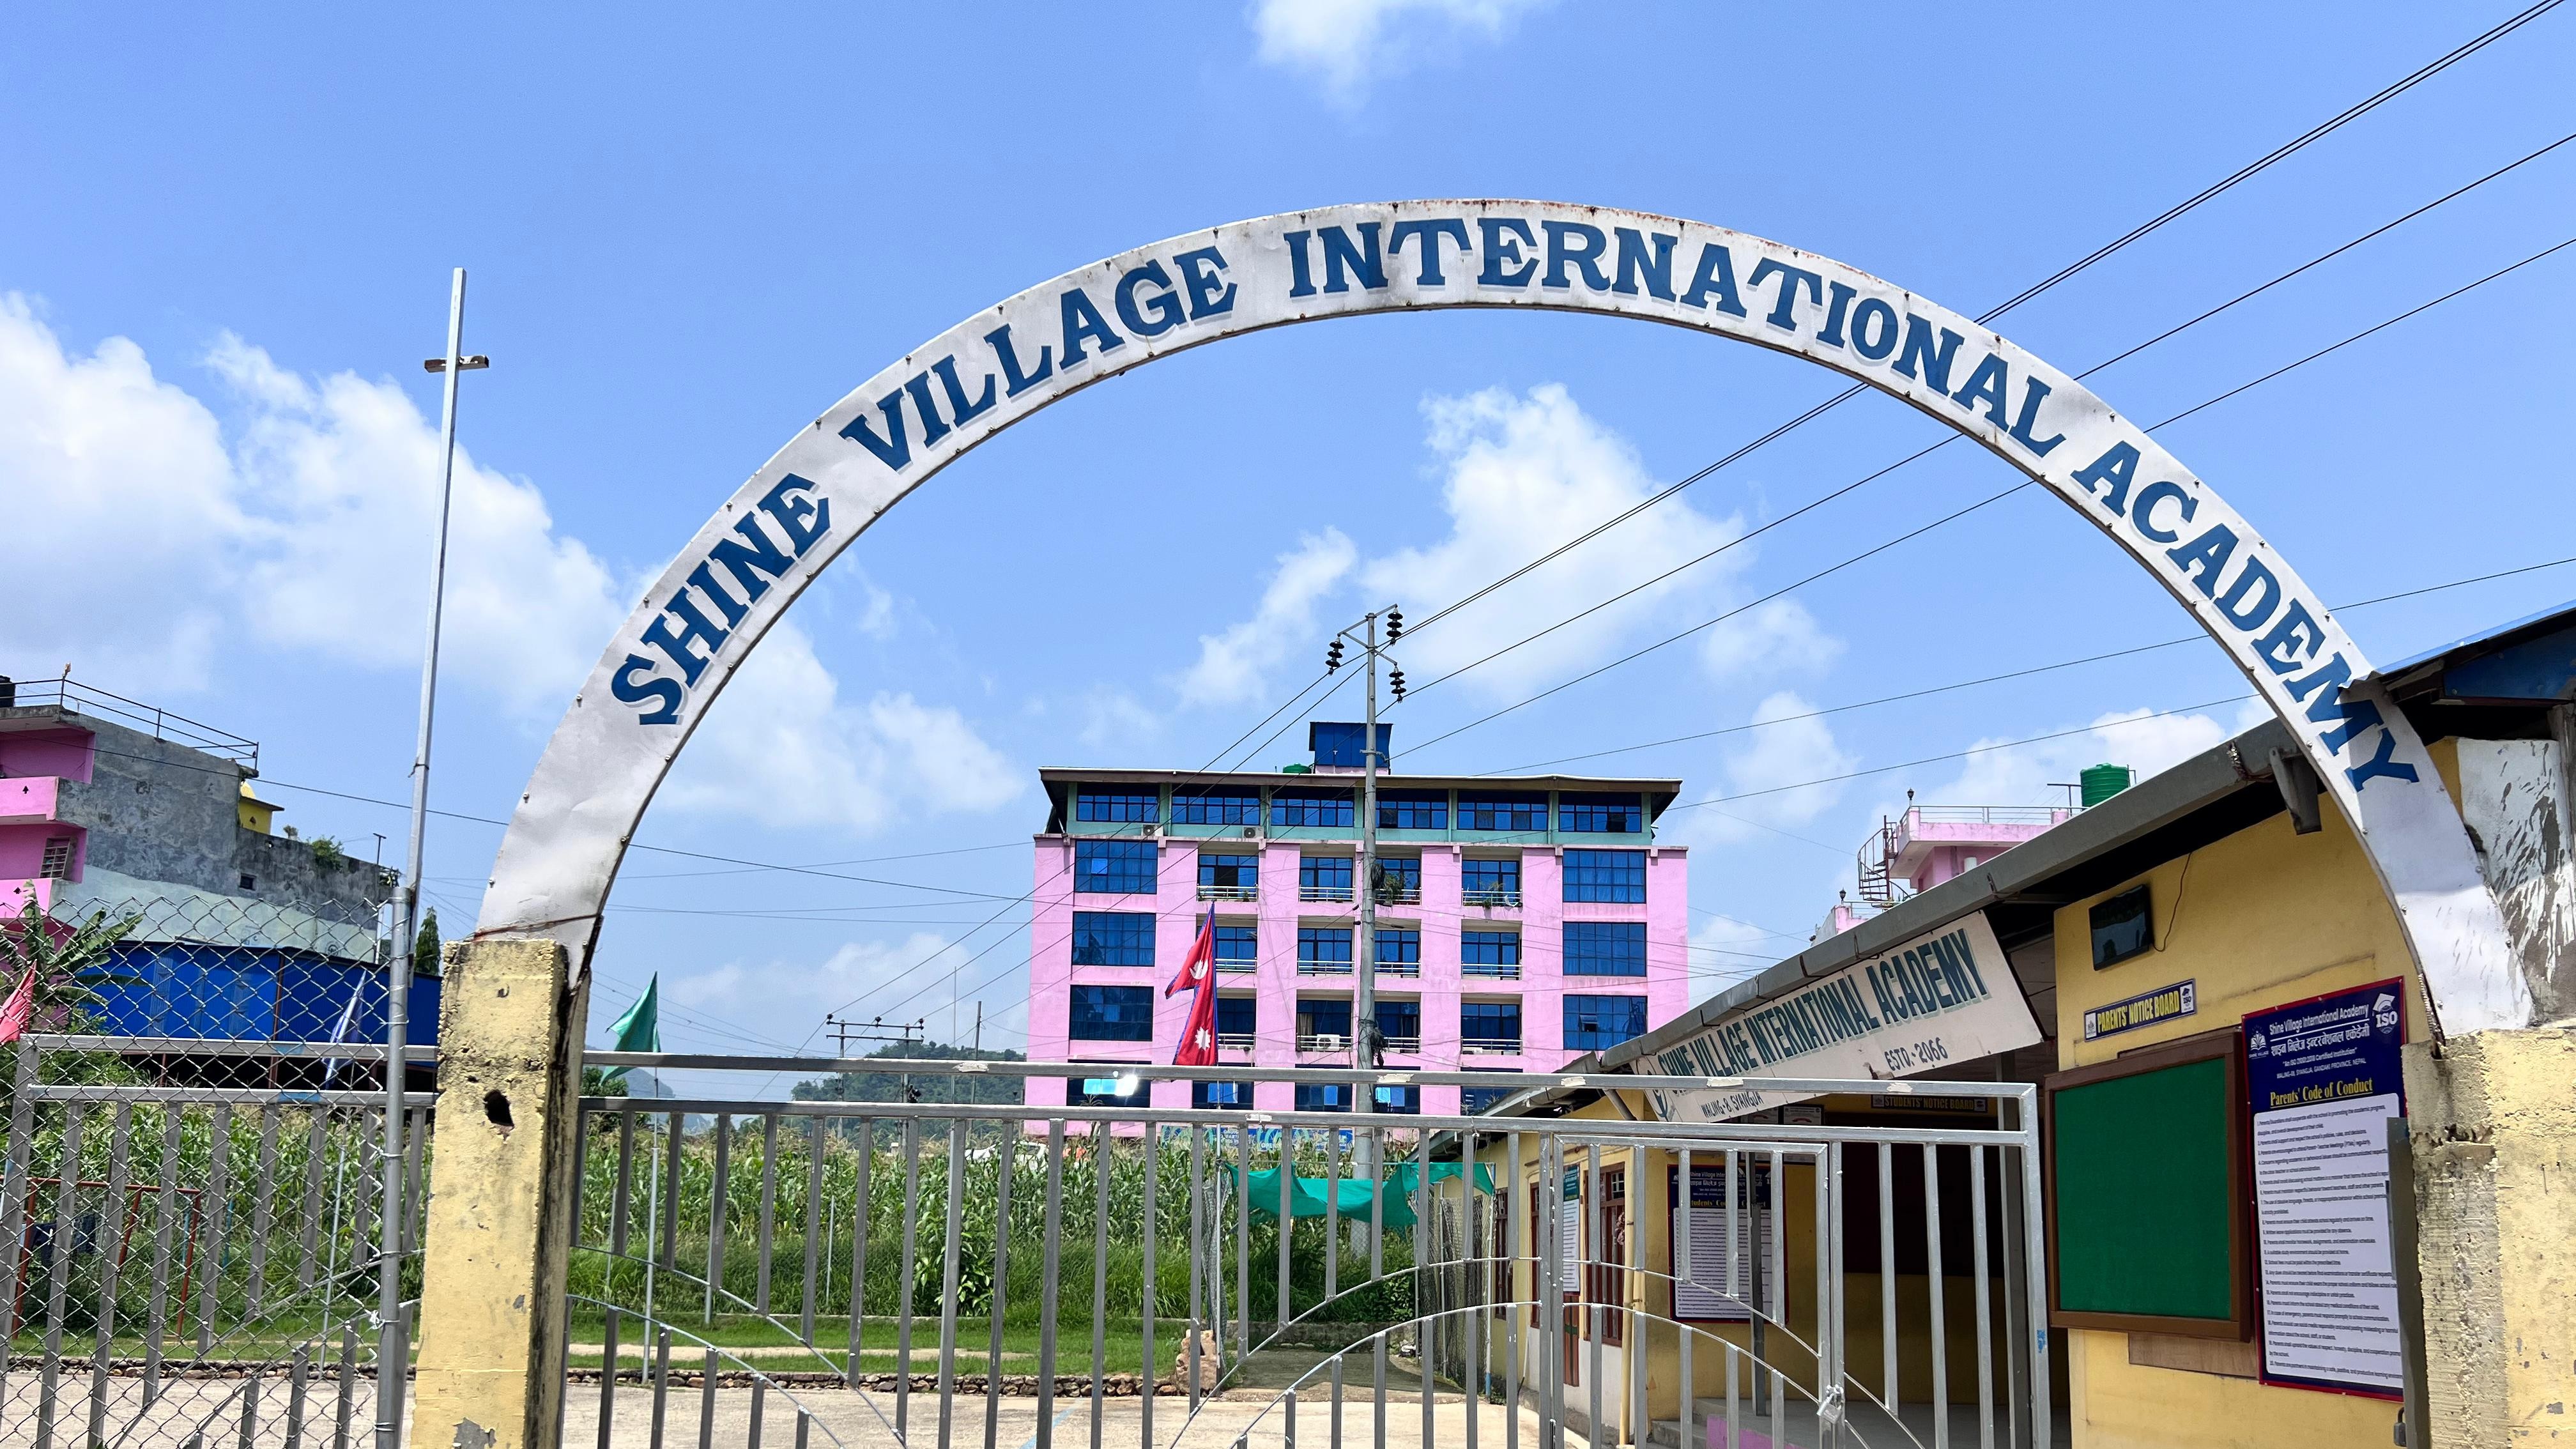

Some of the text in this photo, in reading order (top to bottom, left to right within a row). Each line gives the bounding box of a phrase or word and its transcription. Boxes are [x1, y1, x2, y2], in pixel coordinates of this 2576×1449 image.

[612, 219, 2419, 792] SHINE VILLAGE INTERNATIONAL ACADEMY
[1689, 1022, 1759, 1078] VILLAGE
[1743, 974, 1881, 1065] INTERNATIONAL
[1865, 928, 1988, 1025] ACADEMY
[2097, 990, 2180, 1033] PARENTS' NOTICE BOARD
[2269, 1004, 2369, 1036] Shine Village International Academy
[2376, 1011, 2398, 1028] ISO
[1885, 1096, 1974, 1110] STUDENTS' NOTICE BOARD
[2270, 1077, 2373, 1106] Parents' Code of Conduct
